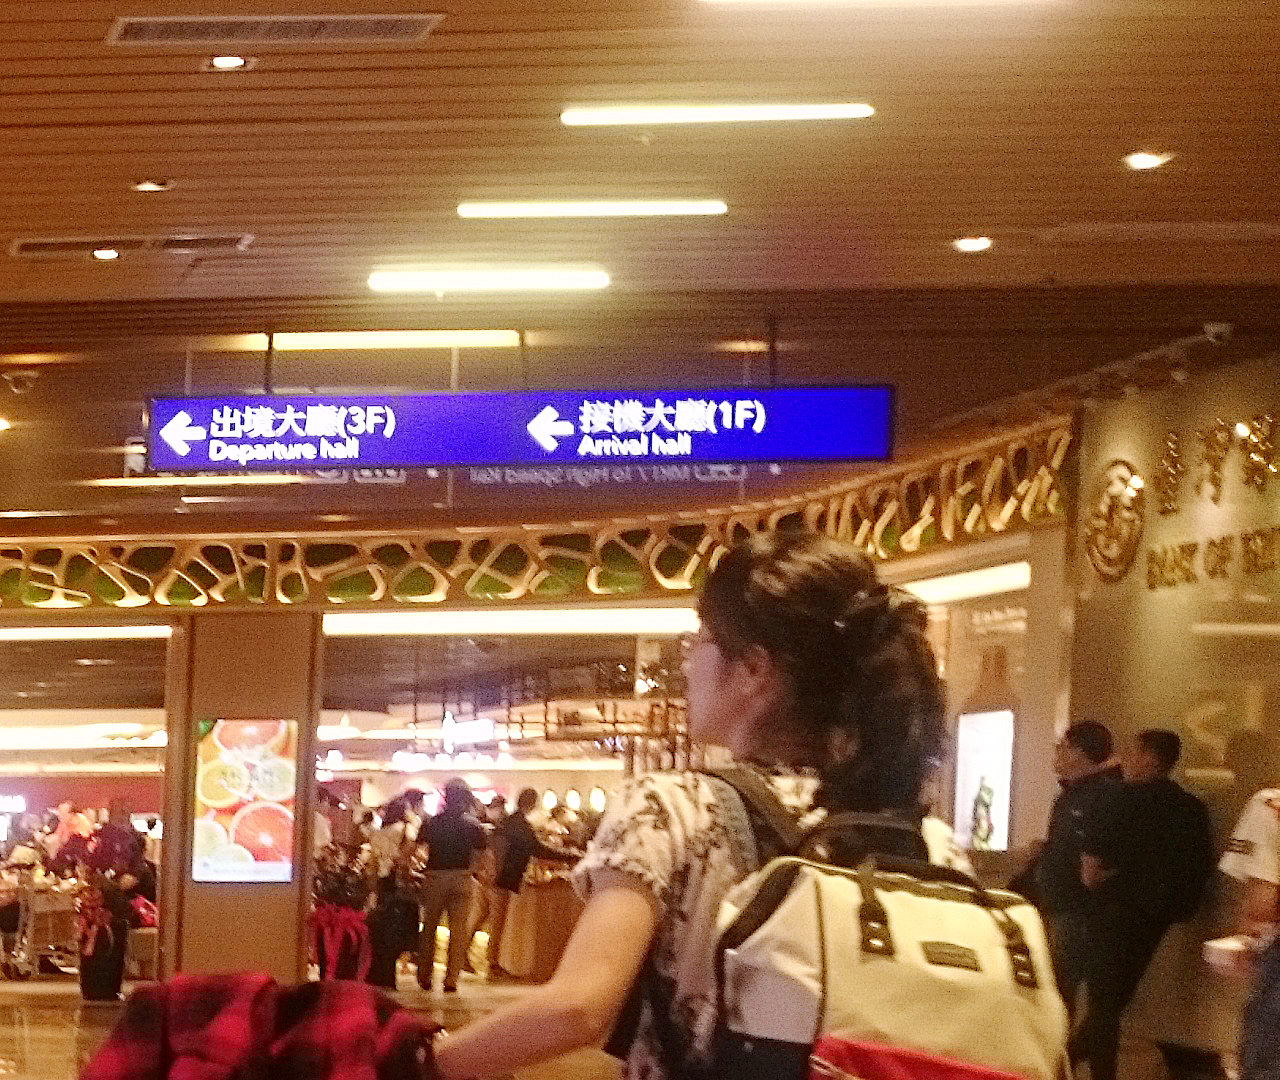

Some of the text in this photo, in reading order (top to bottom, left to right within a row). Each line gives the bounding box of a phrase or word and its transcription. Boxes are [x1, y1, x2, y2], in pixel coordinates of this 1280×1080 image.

[209, 436, 359, 465] Departure hall
[578, 432, 691, 456] Arrival hall
